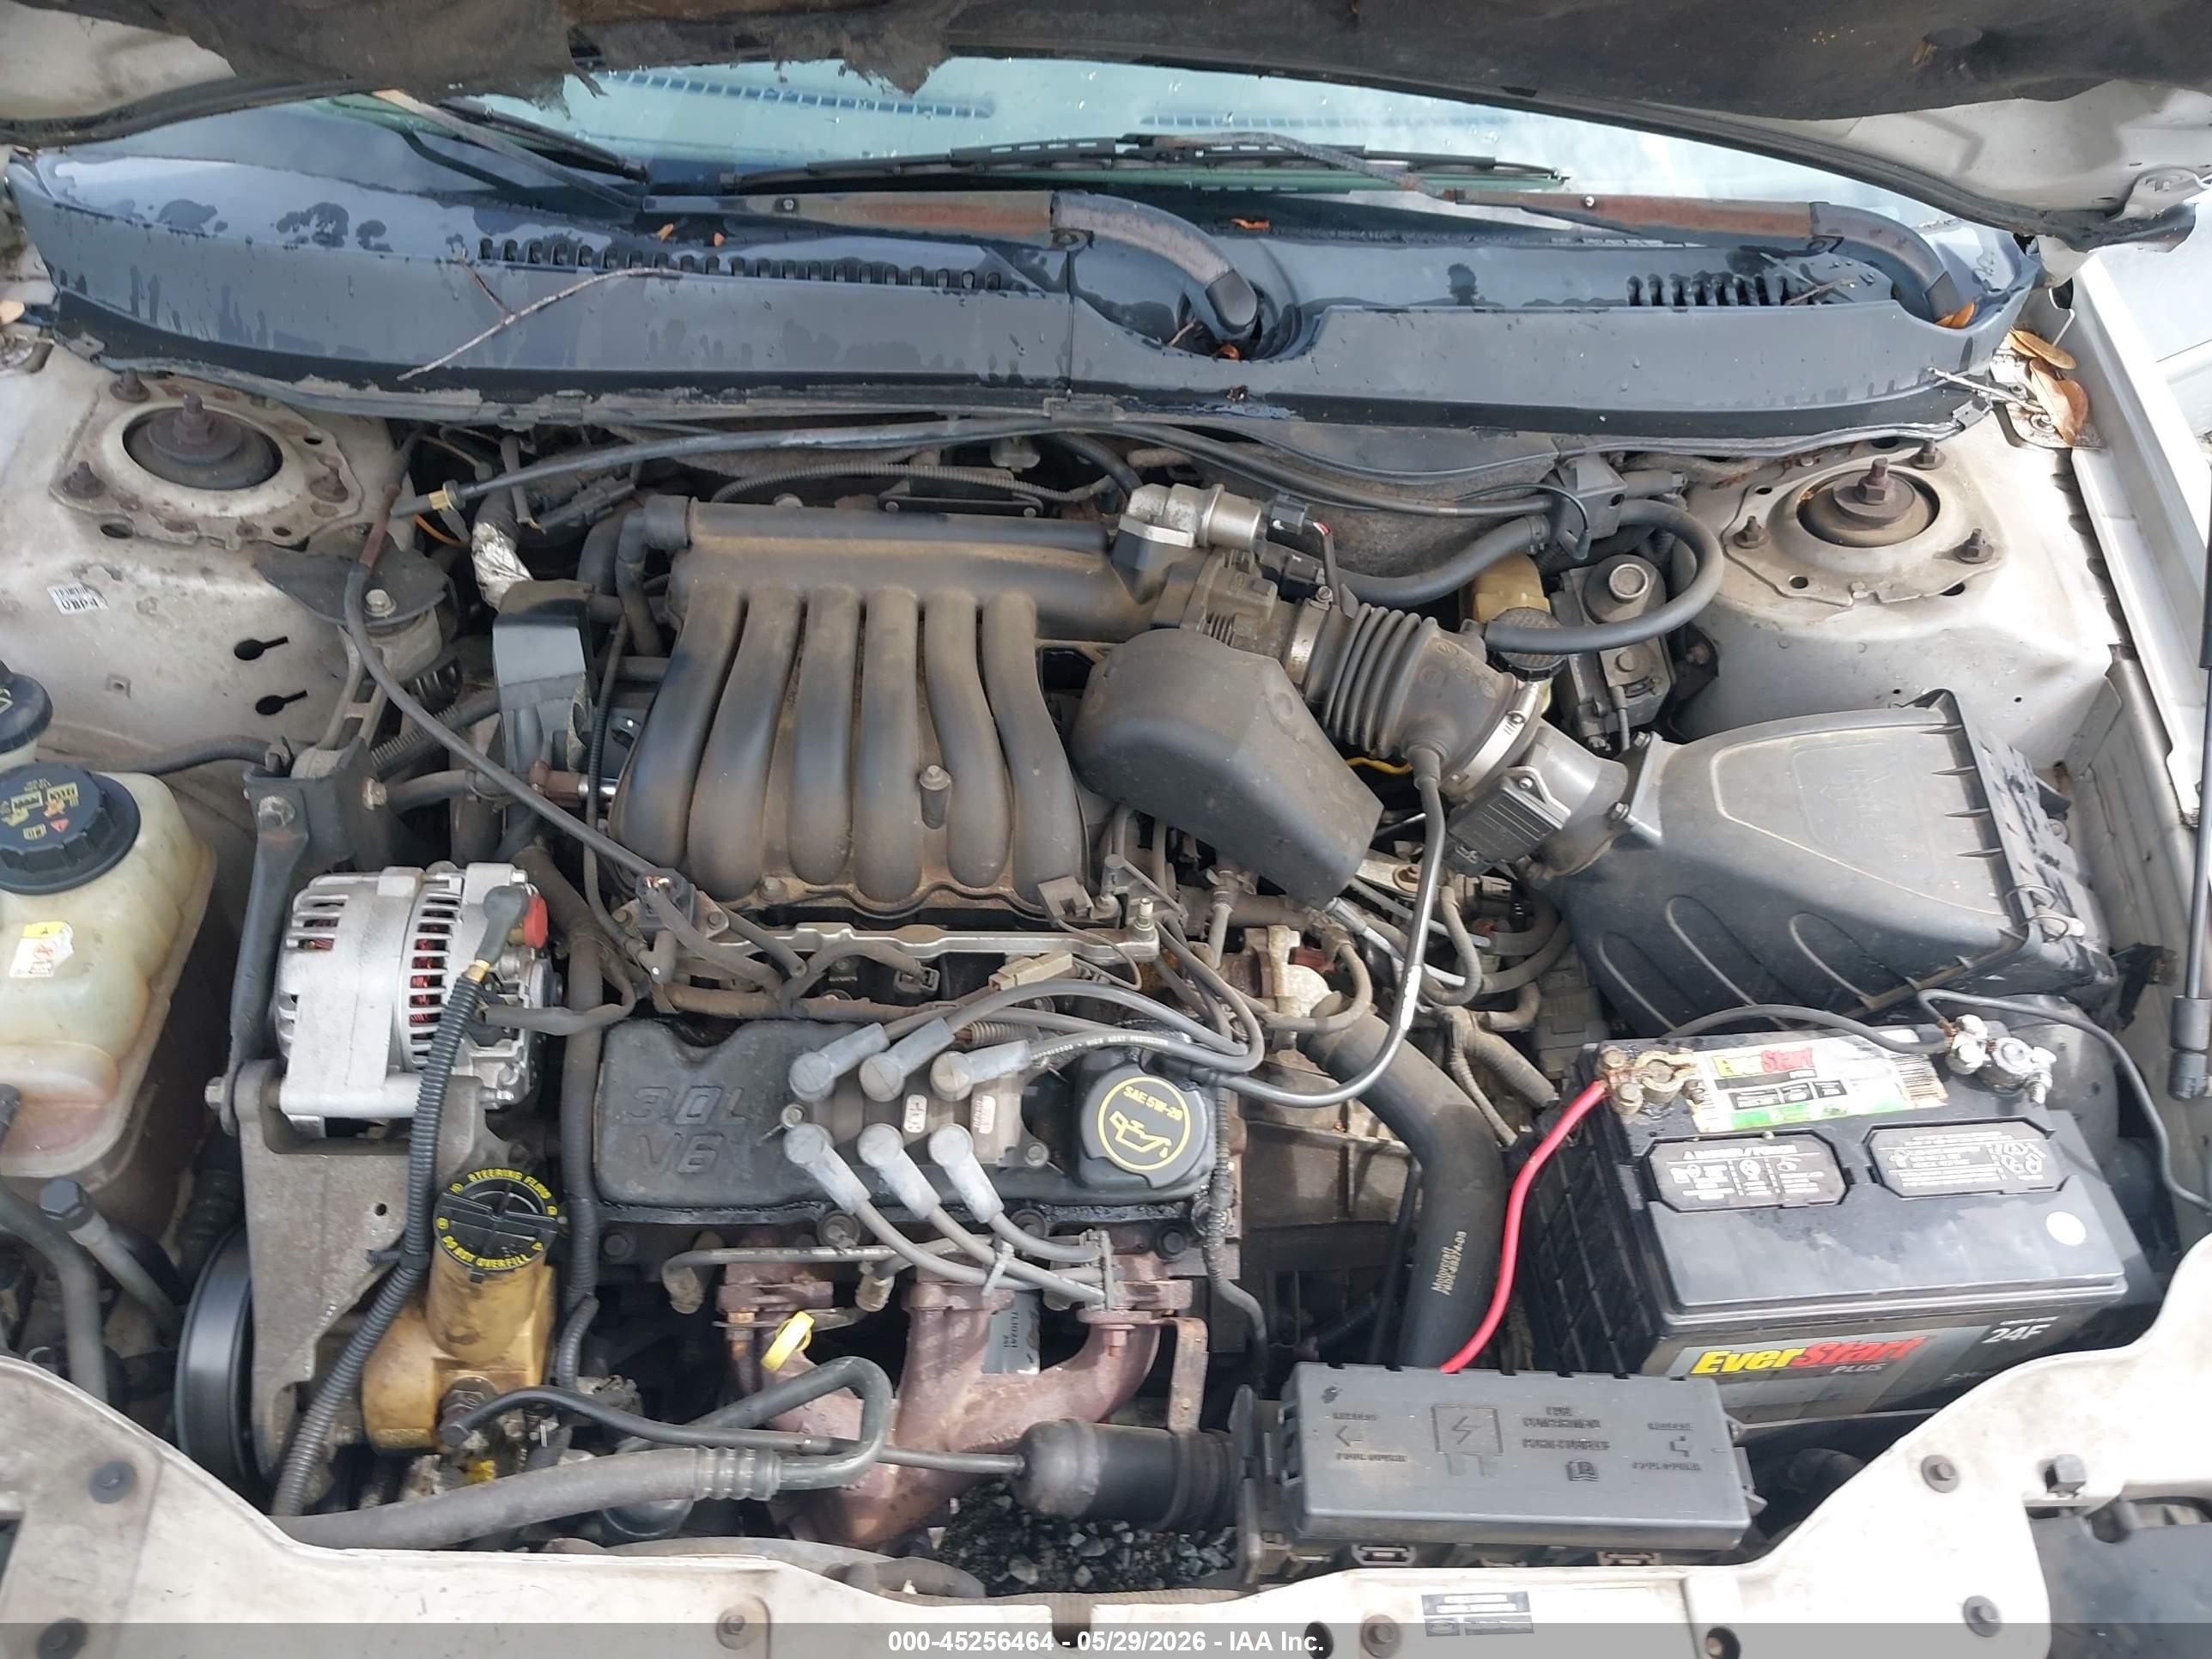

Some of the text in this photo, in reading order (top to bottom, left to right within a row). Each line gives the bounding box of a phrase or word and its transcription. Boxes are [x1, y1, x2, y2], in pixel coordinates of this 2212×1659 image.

[629, 1085, 749, 1124] 3.0L
[1123, 1086, 1183, 1121] SAE 5W-20
[637, 1133, 724, 1174] V6
[467, 1169, 552, 1200] STEERING FLUID
[475, 1254, 532, 1267] OVERFILL
[1980, 1323, 2052, 1344] 24F
[1689, 1336, 1928, 1376] EverStart
[1831, 1362, 1887, 1374] PLUS
